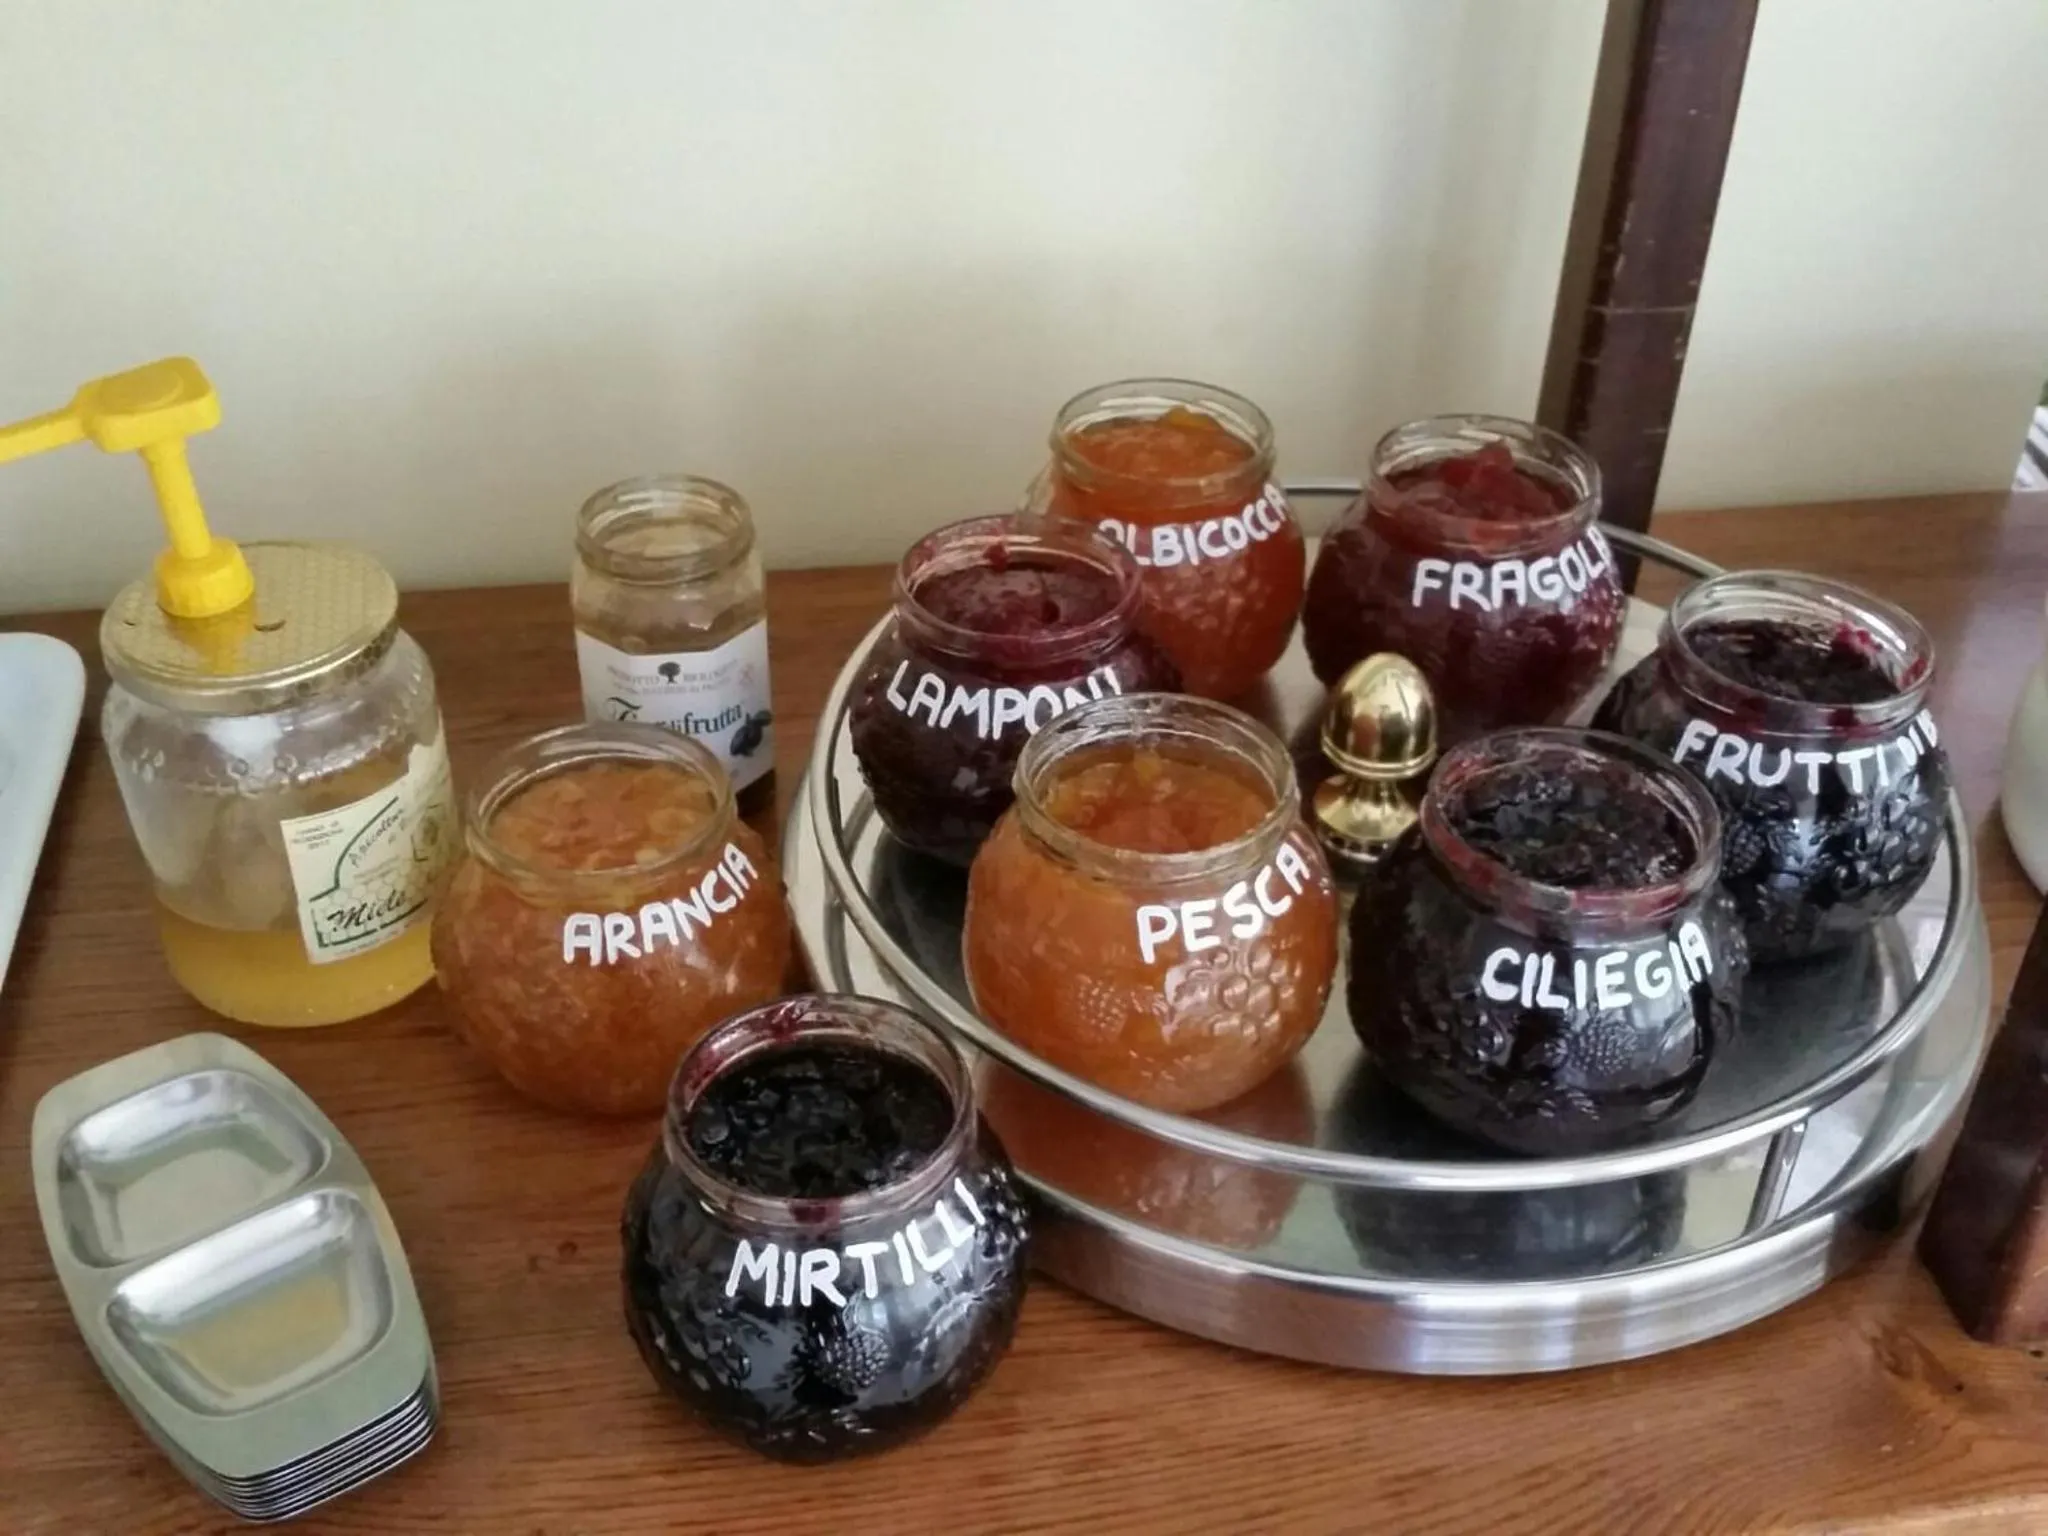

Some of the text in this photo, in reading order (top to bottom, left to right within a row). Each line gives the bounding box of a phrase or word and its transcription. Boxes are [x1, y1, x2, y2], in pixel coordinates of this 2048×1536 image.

[1412, 525, 1612, 611] FRAGOLA
[1672, 718, 1890, 795] FRUTTI
[563, 842, 760, 966] ARANCIA
[1136, 841, 1312, 964] PESCA
[1481, 921, 1713, 1011] CILIEGIA
[725, 1178, 986, 1308] MIRTILLI
